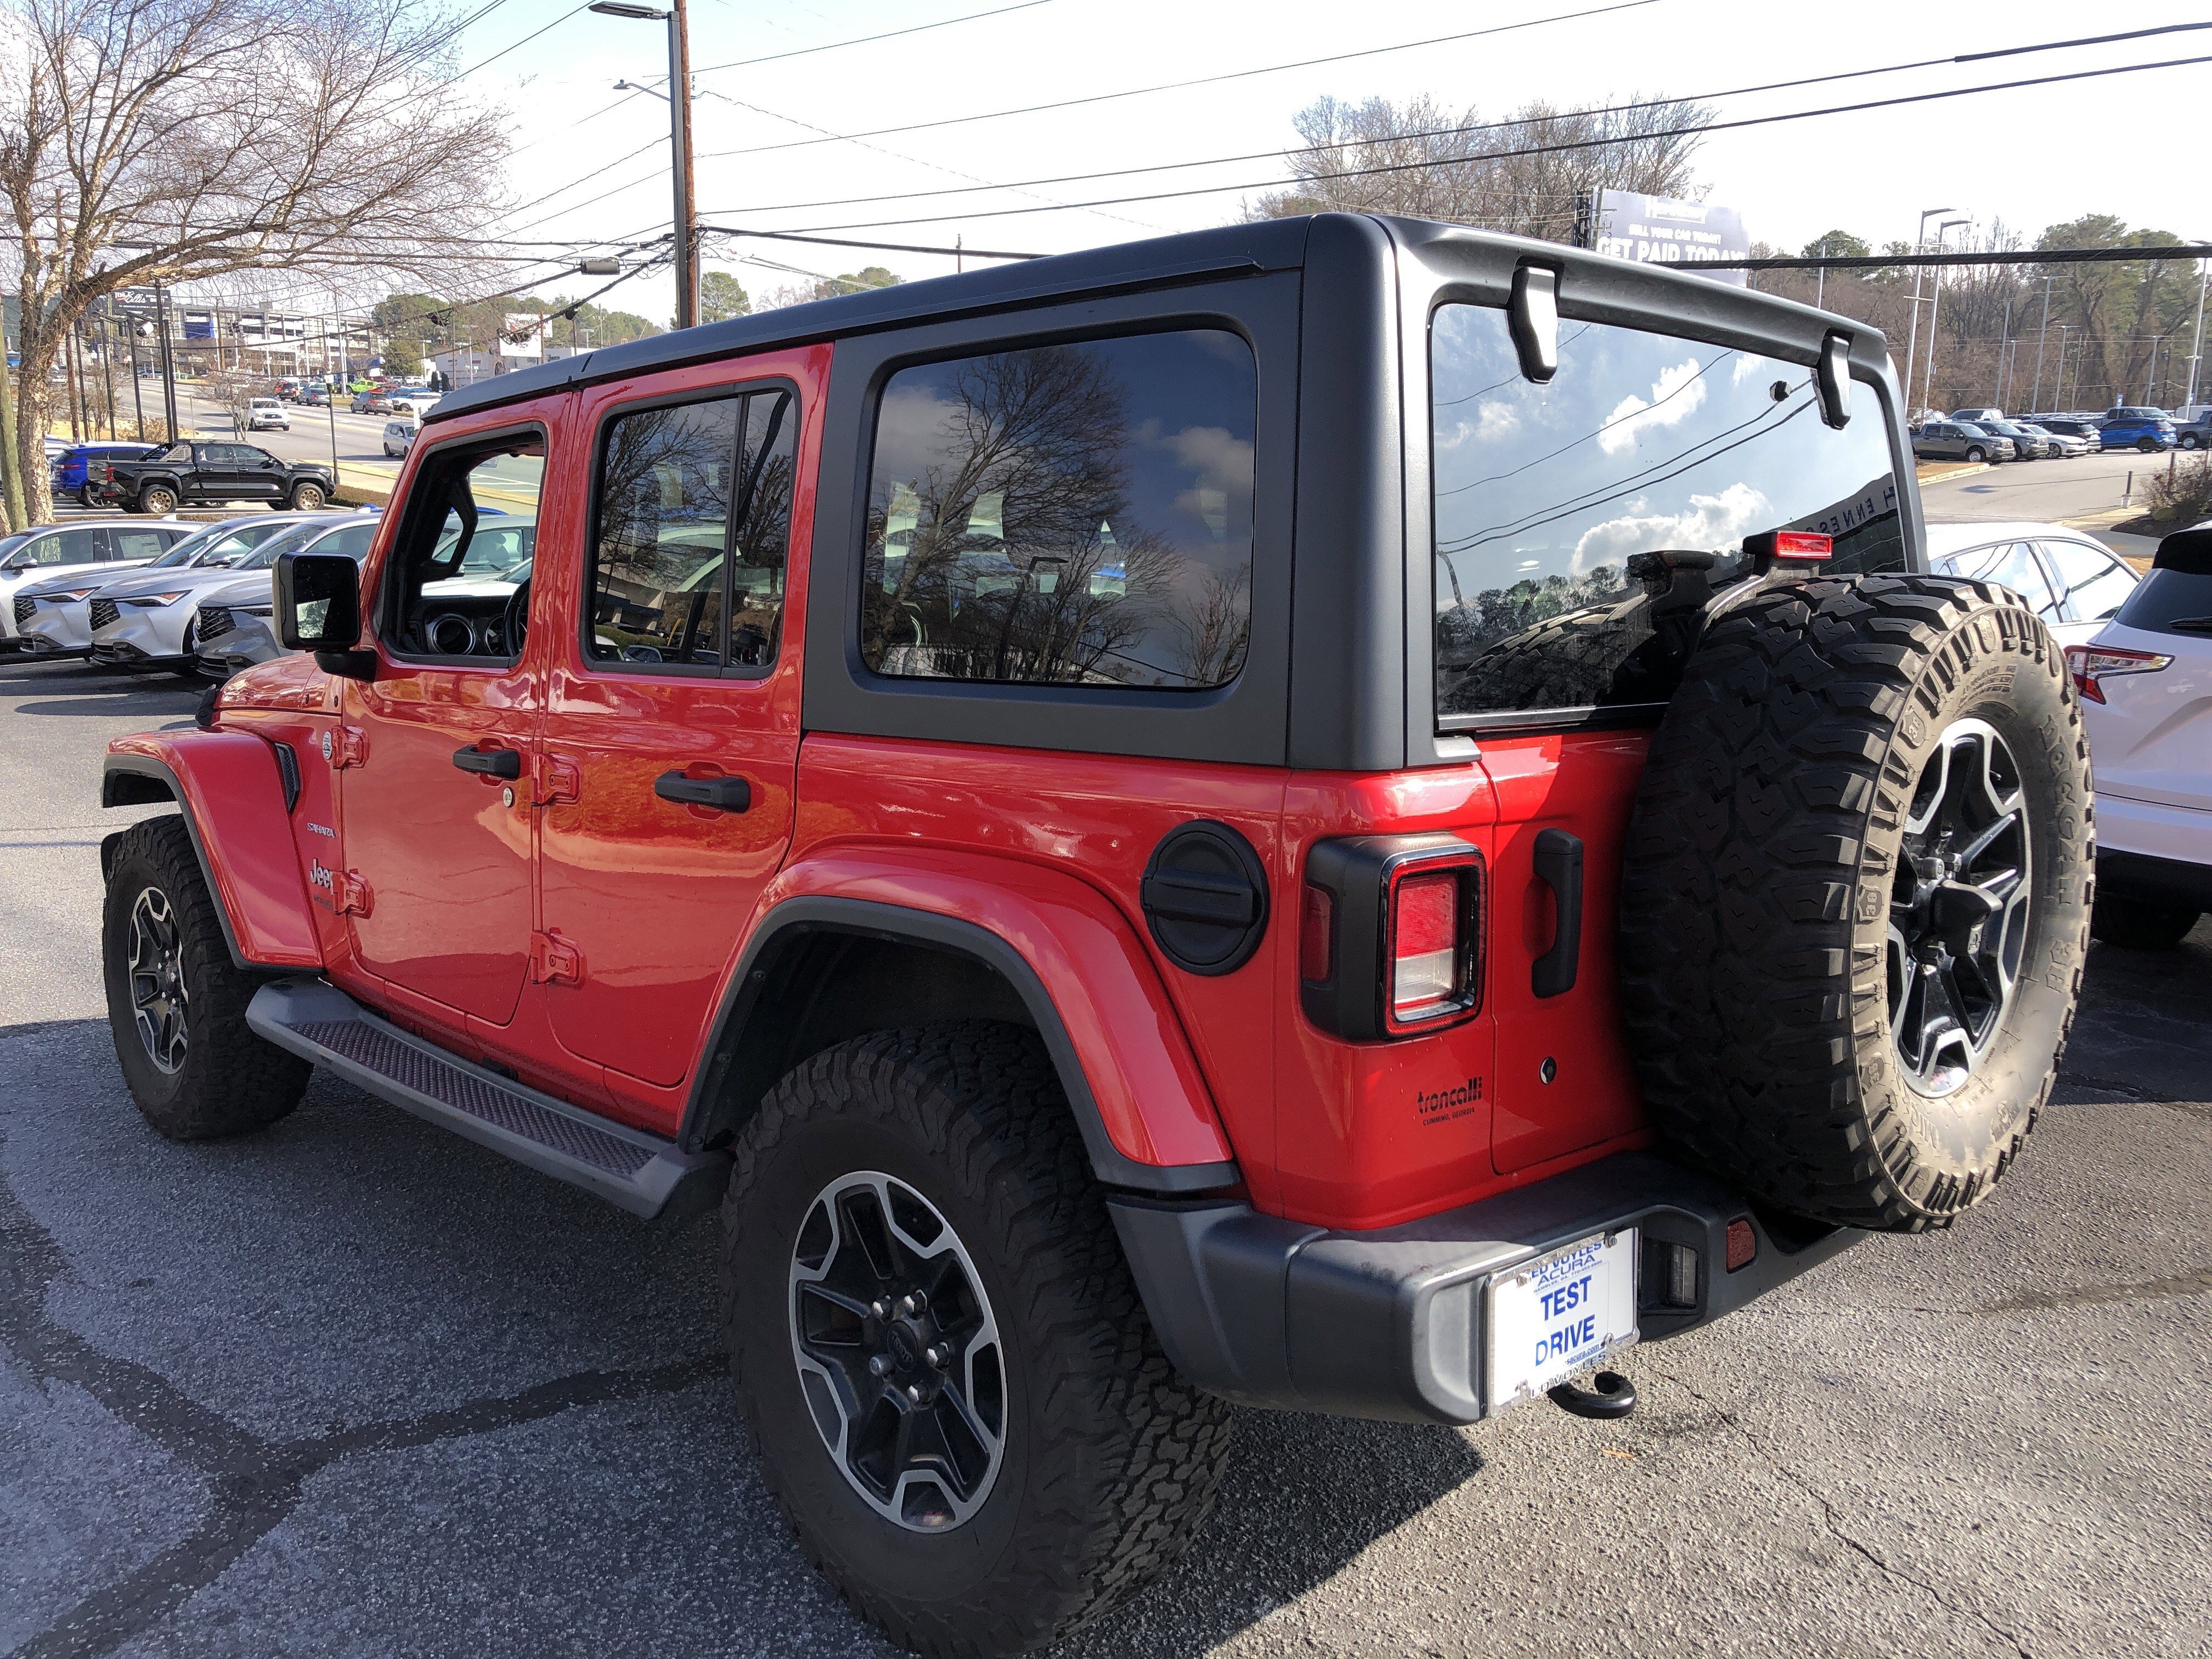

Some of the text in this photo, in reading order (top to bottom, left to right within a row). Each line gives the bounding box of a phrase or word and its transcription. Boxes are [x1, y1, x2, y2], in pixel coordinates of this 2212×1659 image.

[1596, 236, 1746, 273] GET PAID TODAY!
[307, 822, 336, 838] SAHARA
[1417, 1076, 1482, 1114] troncalli
[1538, 1254, 1596, 1286] ACURA
[1540, 1274, 1592, 1322] TEST
[1536, 1314, 1595, 1367] DRIVE
[1554, 1350, 1607, 1387] VOYLES
